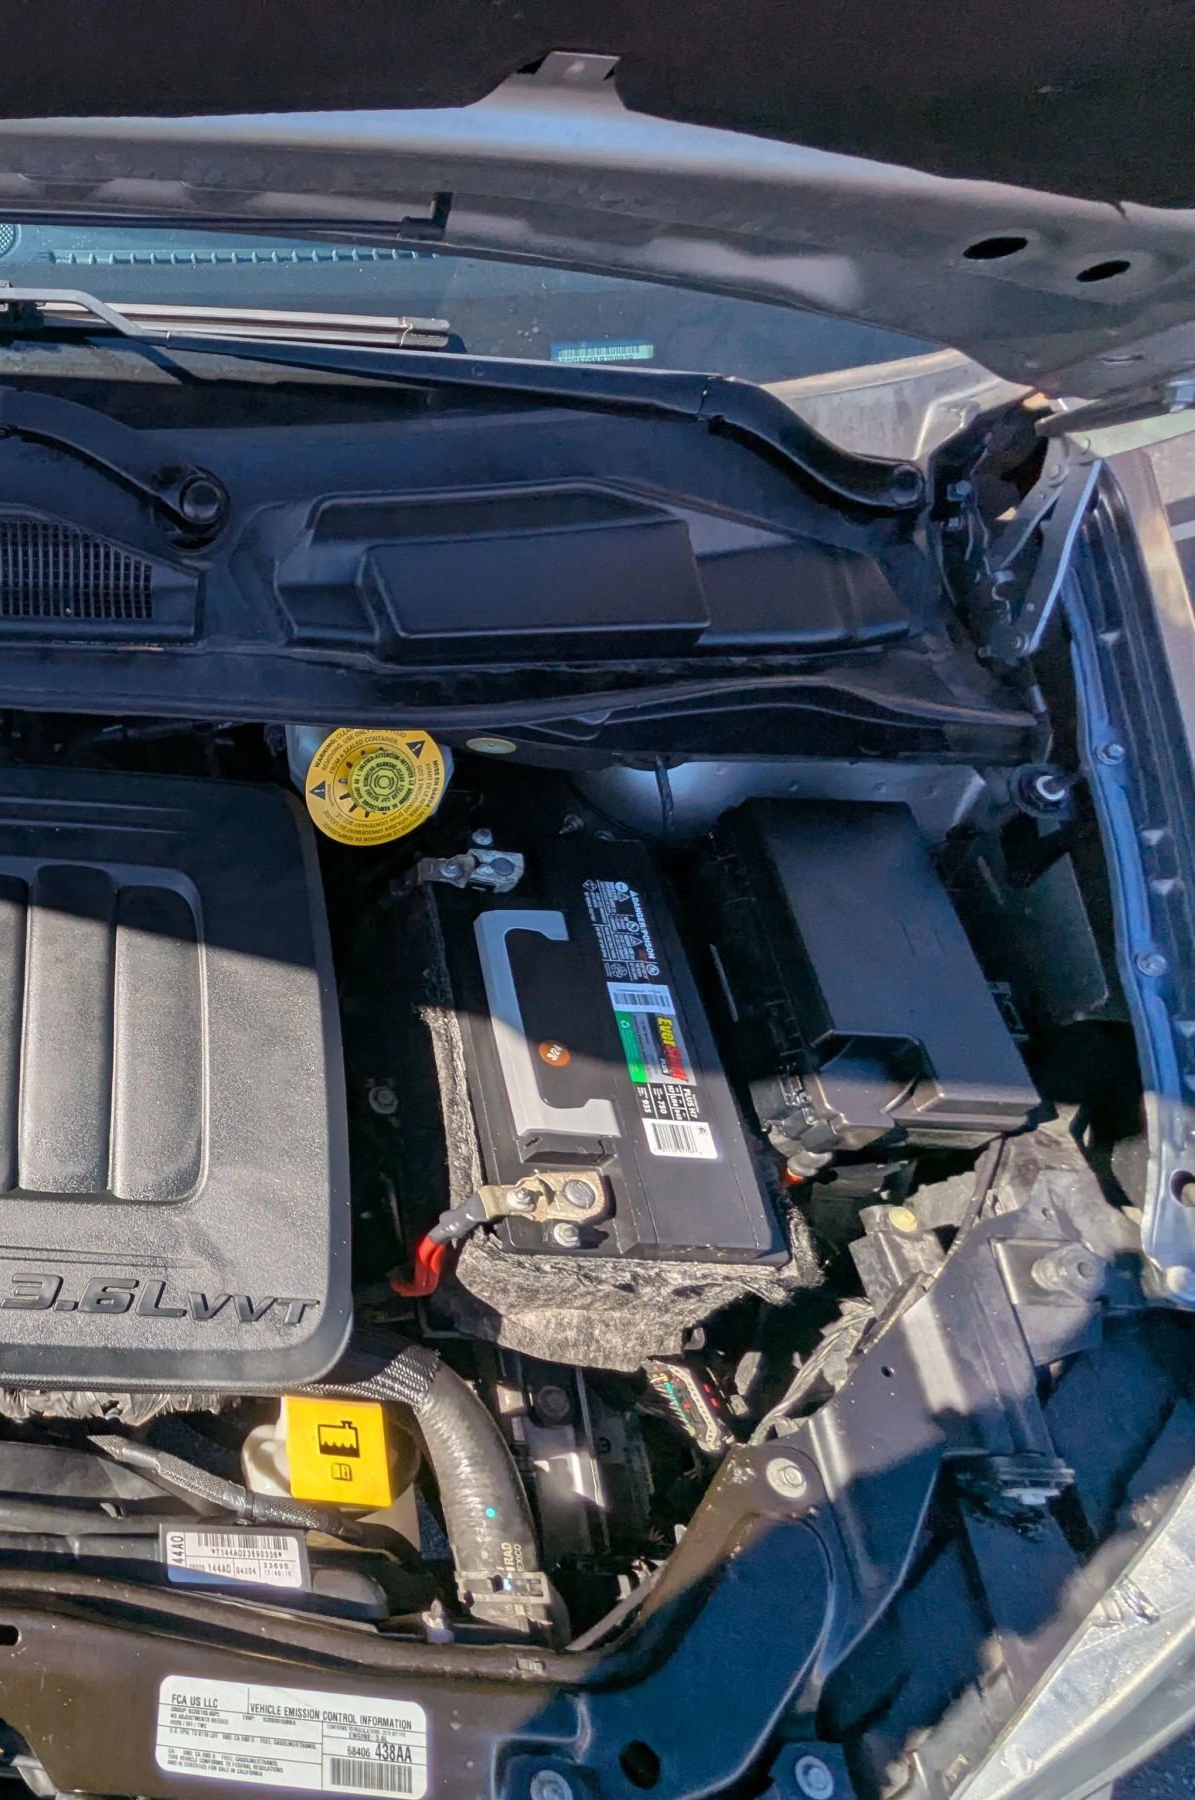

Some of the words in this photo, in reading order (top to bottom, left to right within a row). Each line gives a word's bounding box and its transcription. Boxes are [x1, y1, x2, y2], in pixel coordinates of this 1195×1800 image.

[343, 734, 354, 745] USE
[314, 739, 336, 768] WARNING:
[329, 760, 340, 774] FROM
[345, 739, 364, 756] SEALED
[658, 1100, 668, 1115] 750
[683, 1088, 694, 1108] PLUS
[689, 1107, 698, 1119] H7
[513, 1543, 524, 1572] EXICO
[171, 1693, 187, 1705] FCA
[190, 1696, 201, 1707] US
[204, 1697, 218, 1709] LLC
[250, 1703, 281, 1716] VEHICLE
[284, 1706, 320, 1719] EMISSION
[323, 1711, 357, 1724] CONTROL
[360, 1715, 412, 1730] INFORMATION
[349, 1732, 374, 1741] ENGINE:
[347, 1745, 370, 1758] 68406
[375, 1743, 412, 1763] 438AA
